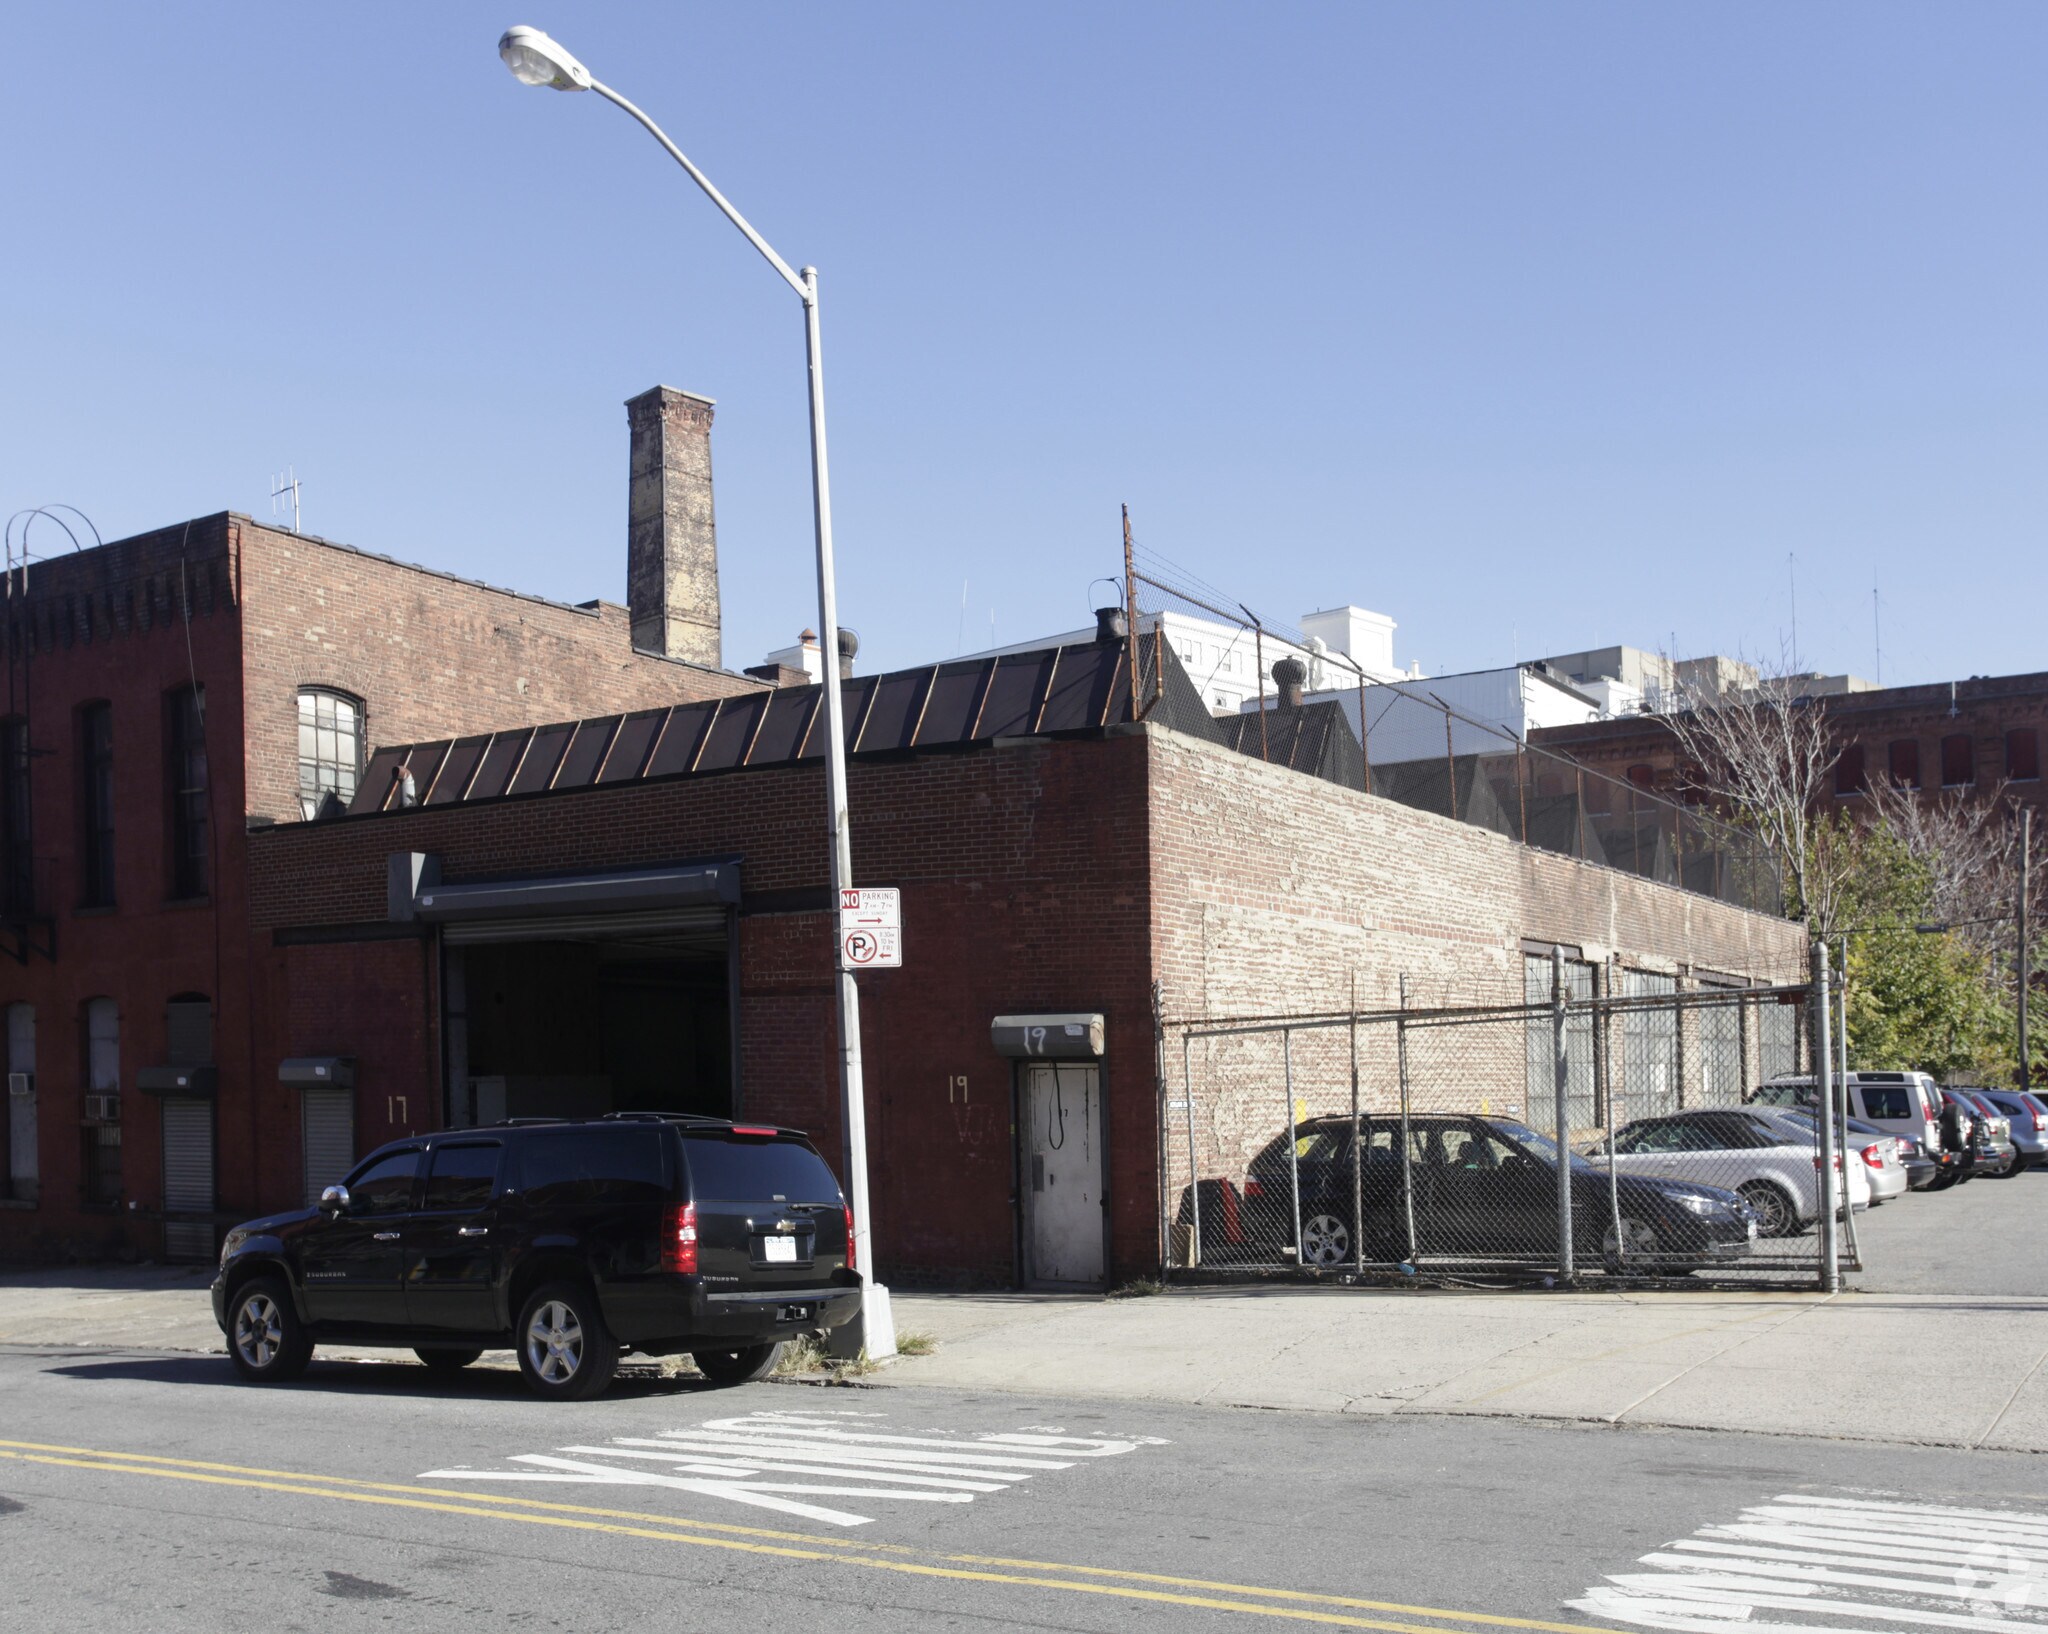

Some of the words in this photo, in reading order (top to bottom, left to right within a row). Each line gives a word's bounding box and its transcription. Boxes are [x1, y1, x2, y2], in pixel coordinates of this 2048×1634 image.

[842, 892, 859, 907] NO
[862, 892, 894, 900] PARKING
[1023, 1026, 1047, 1055] 19
[949, 1075, 968, 1103] 19
[388, 1095, 407, 1124] 17
